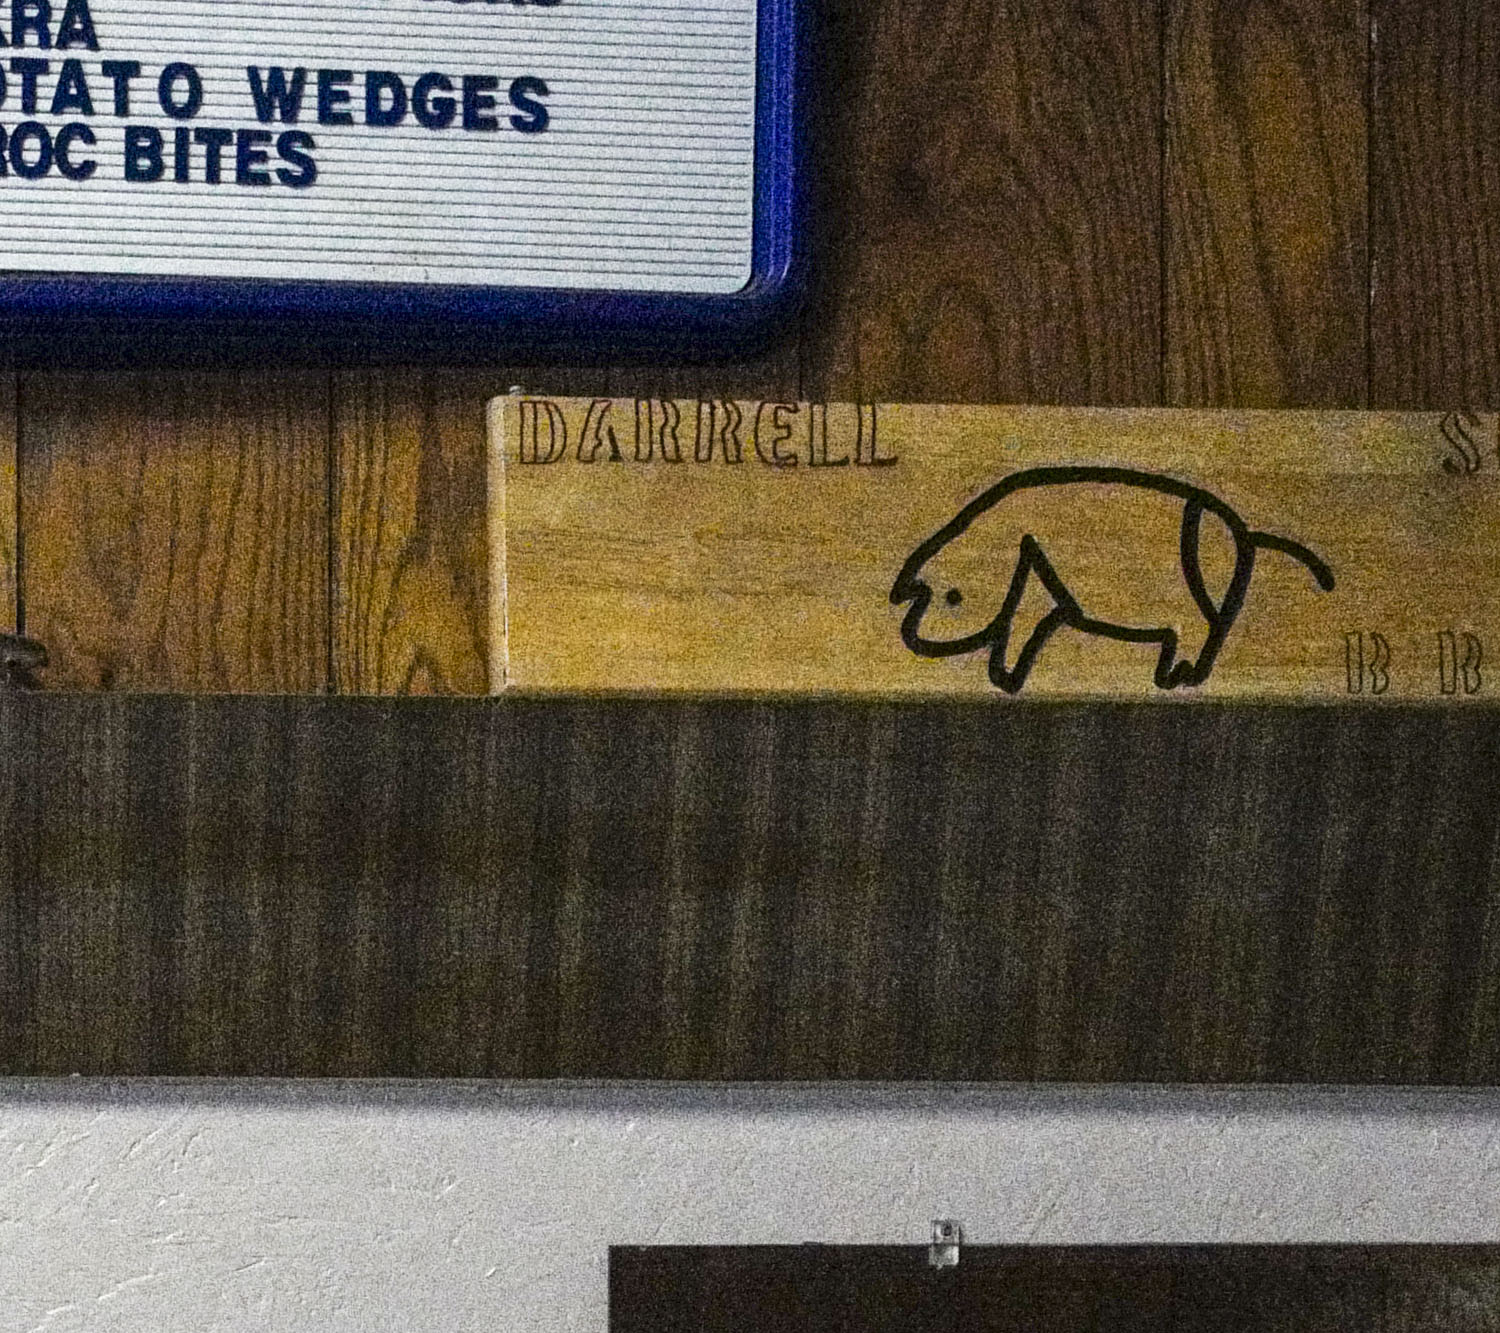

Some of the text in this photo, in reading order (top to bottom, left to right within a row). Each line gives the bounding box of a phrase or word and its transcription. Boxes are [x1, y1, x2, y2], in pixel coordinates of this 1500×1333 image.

[245, 64, 551, 134] WEDGES
[123, 125, 319, 188] BITES
[518, 399, 898, 468] DARRELL
